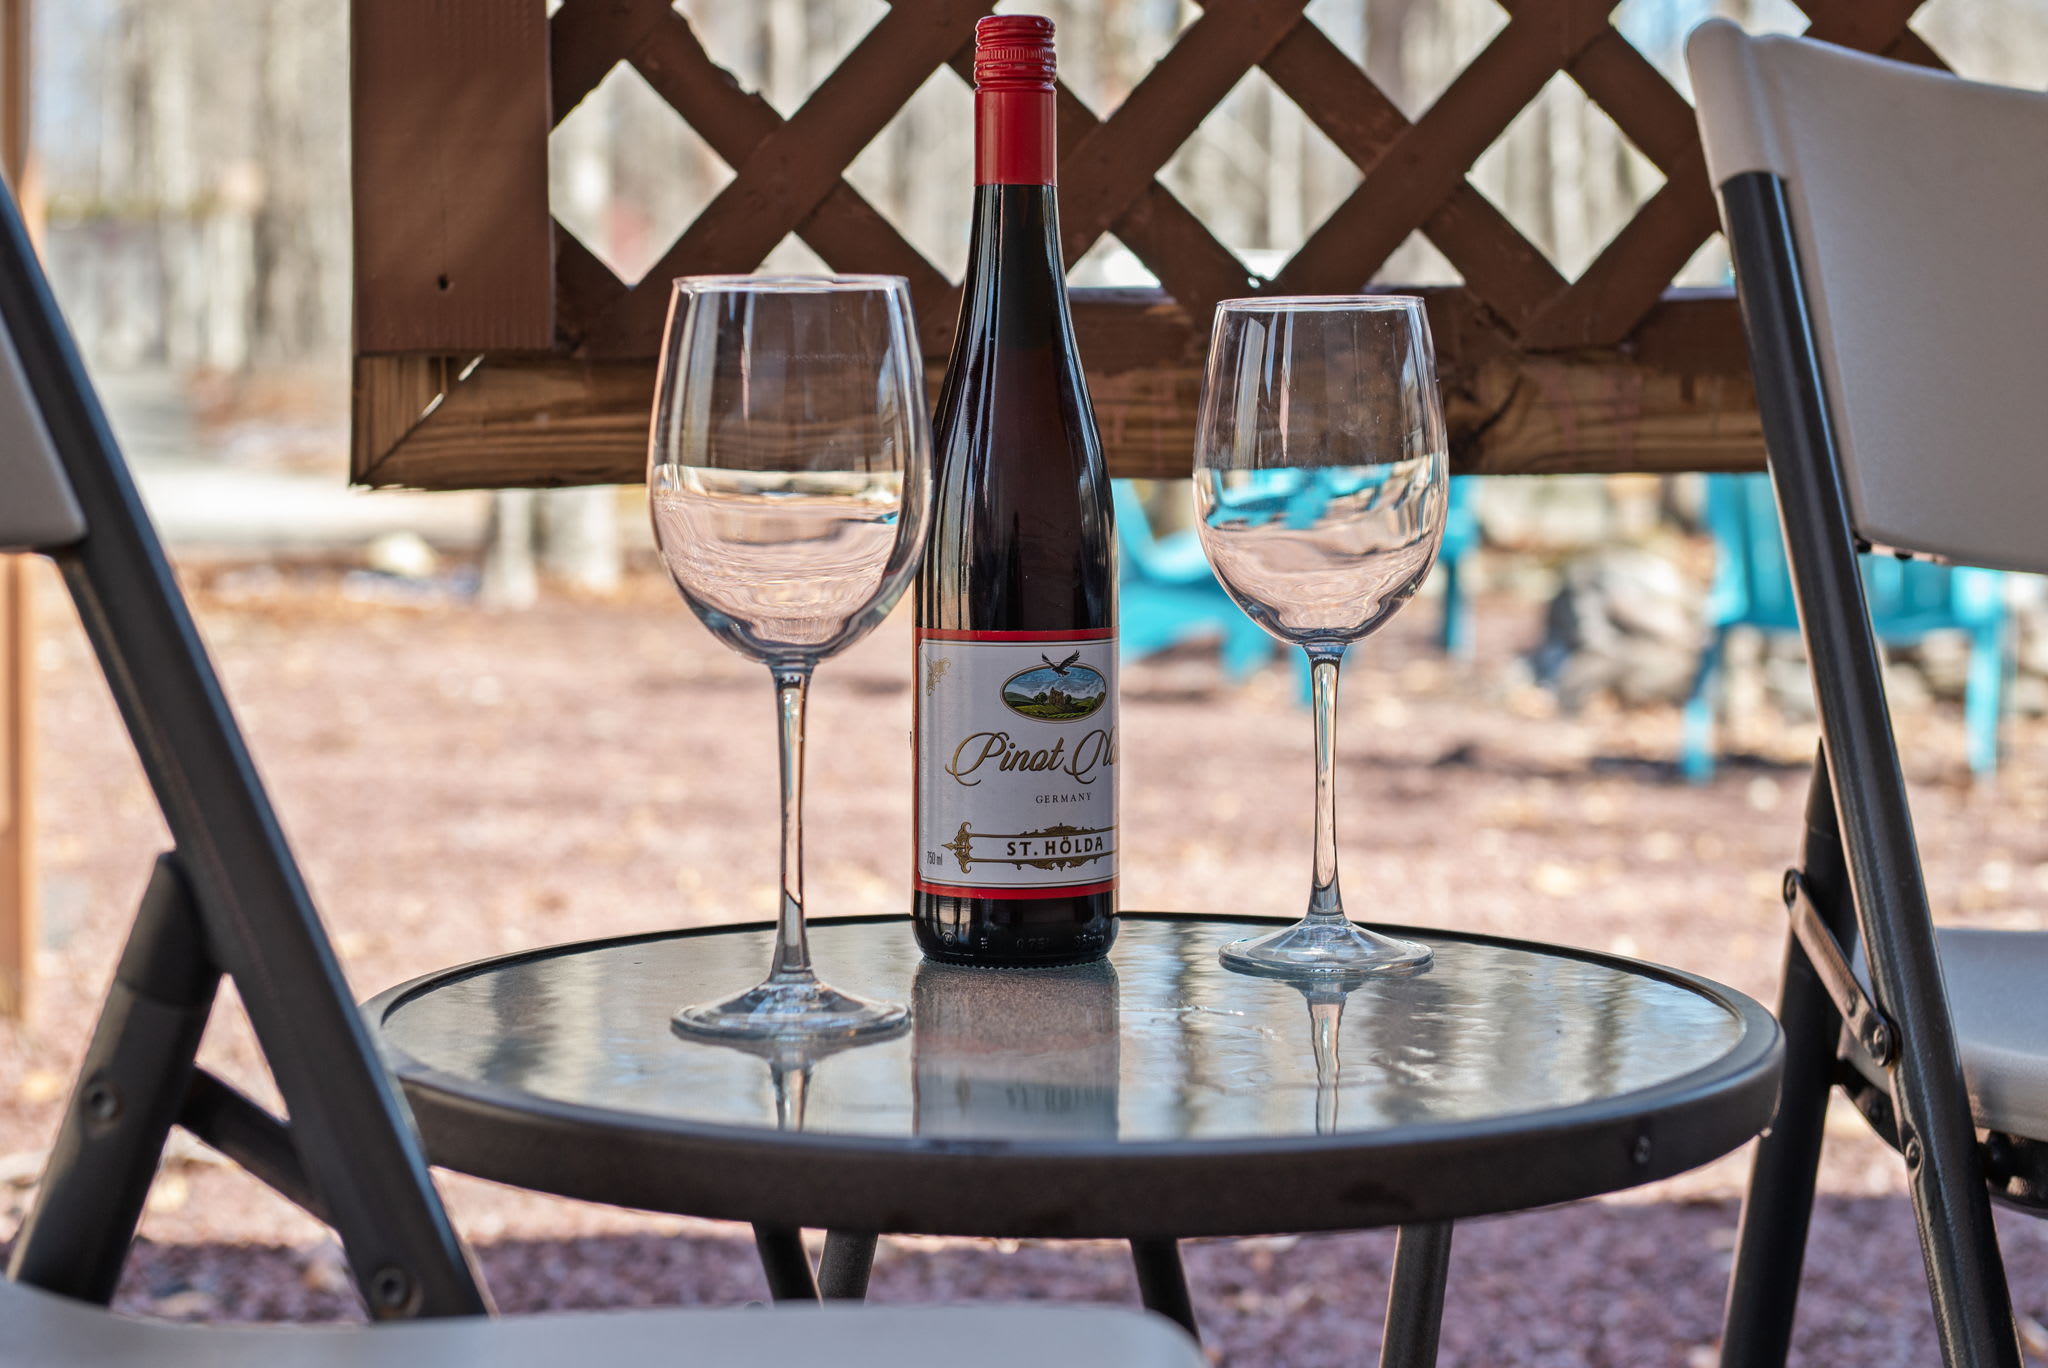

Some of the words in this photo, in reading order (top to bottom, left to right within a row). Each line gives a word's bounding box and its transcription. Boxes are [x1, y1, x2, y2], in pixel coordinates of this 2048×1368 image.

[945, 731, 1065, 786] Pinot
[1035, 792, 1092, 804] GERMANY
[1007, 841, 1038, 856] ST.
[1045, 836, 1103, 856] HÖLDA
[926, 851, 936, 865] 750
[936, 853, 943, 866] ml
